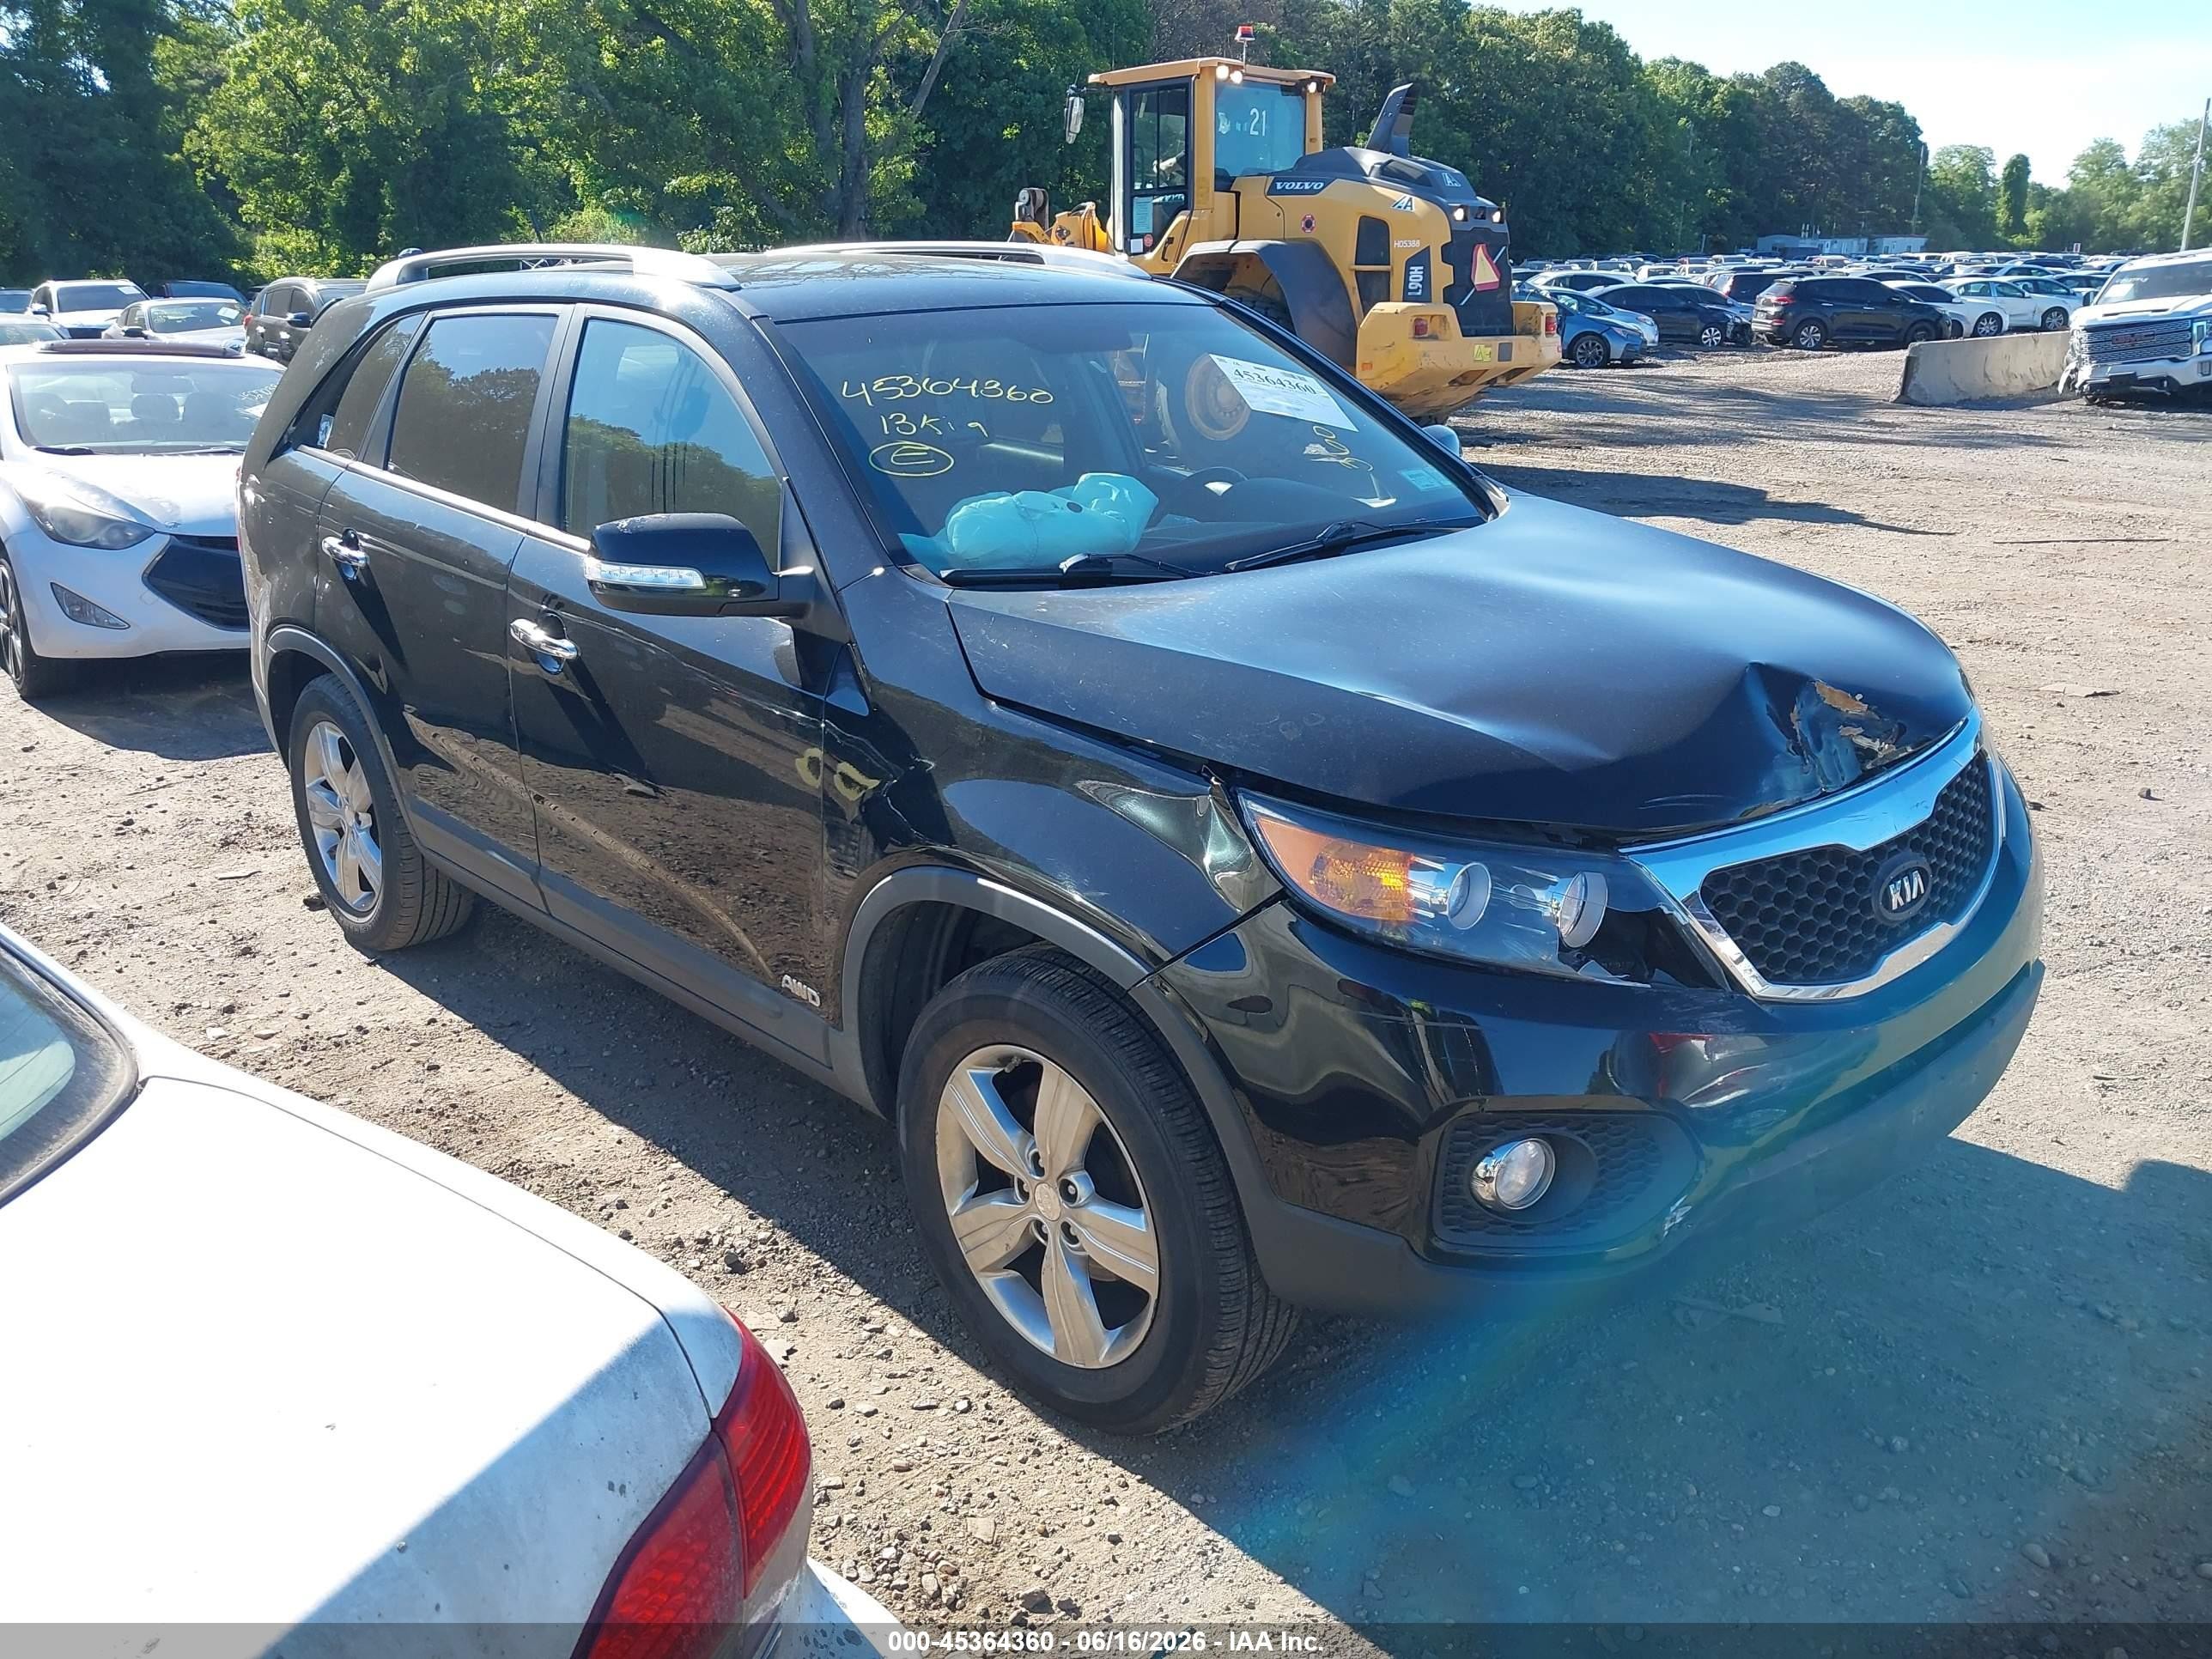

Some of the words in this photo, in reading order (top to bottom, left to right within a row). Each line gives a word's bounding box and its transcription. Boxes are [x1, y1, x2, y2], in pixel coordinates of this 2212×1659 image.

[1249, 107, 1267, 137] 21
[1275, 180, 1325, 191] VOLVO
[1407, 265, 1424, 296] L90H
[842, 375, 1054, 407] 45364360
[1233, 368, 1317, 395] 45364360
[1889, 870, 1925, 911] KIA
[781, 974, 821, 1007] AWD
